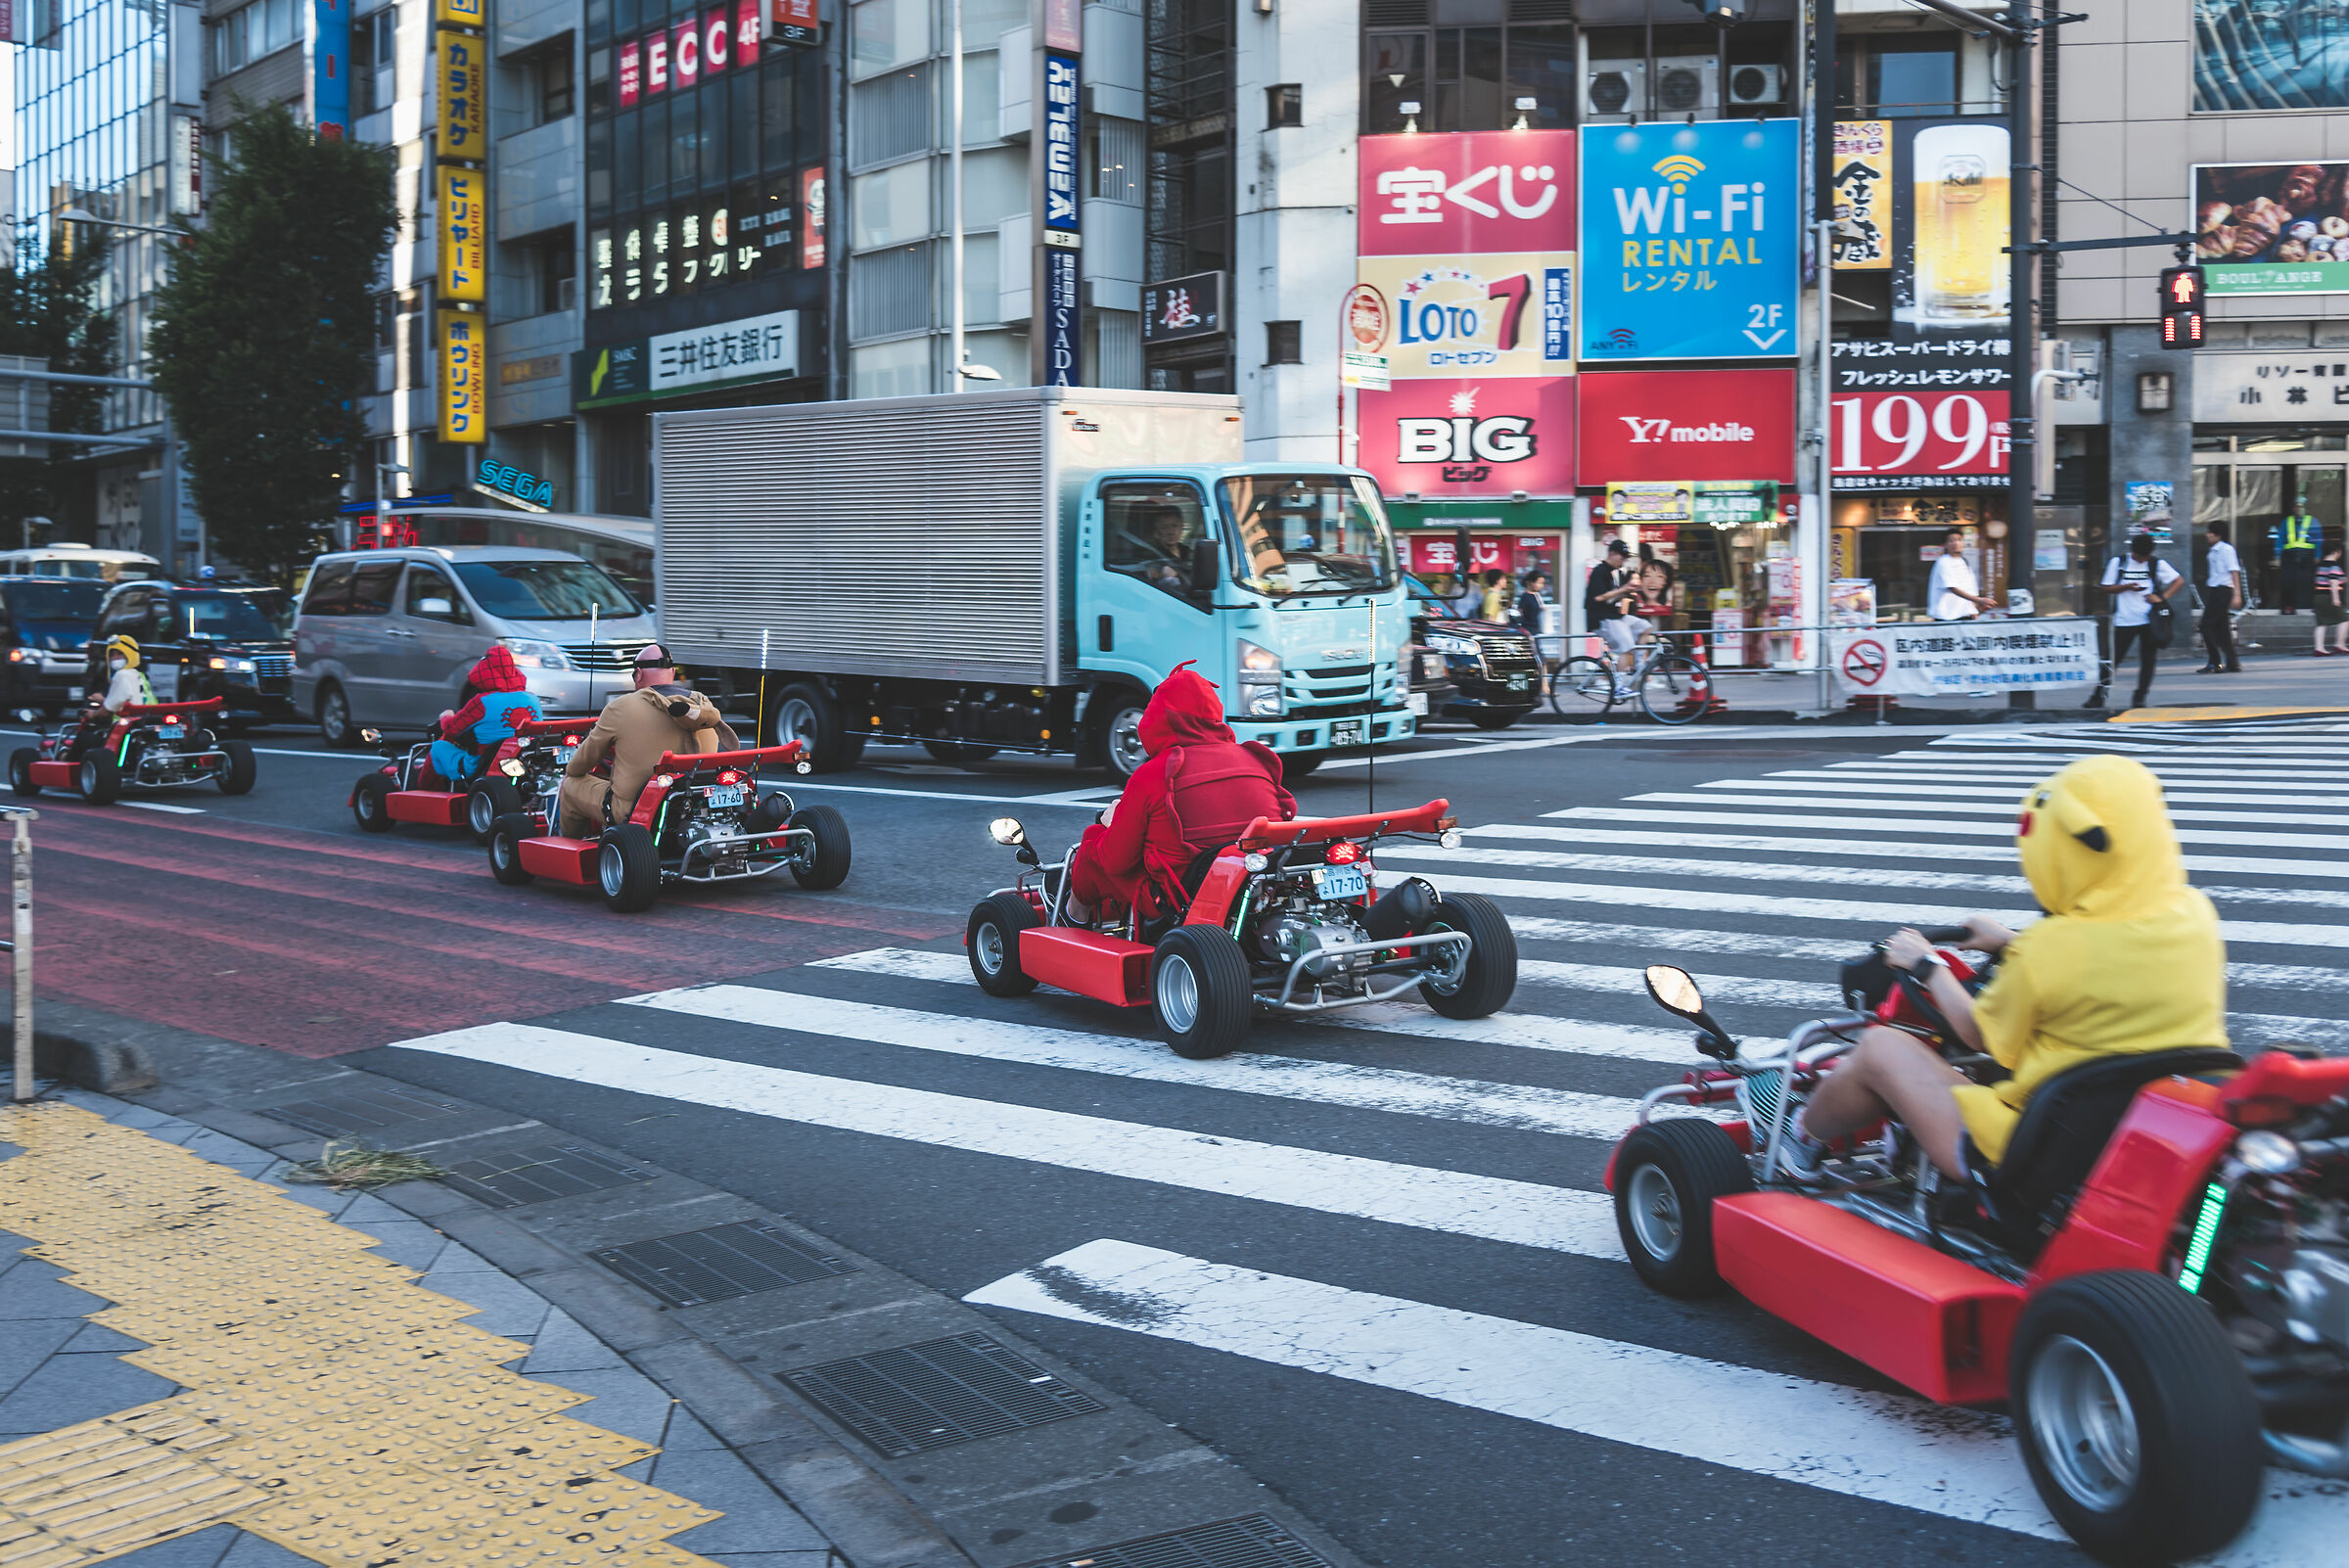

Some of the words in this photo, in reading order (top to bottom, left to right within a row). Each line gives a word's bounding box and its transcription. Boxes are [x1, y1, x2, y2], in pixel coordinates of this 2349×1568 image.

[650, 21, 727, 85] ECC
[783, 25, 806, 38] 3F
[449, 43, 468, 146] カラオケ
[1048, 61, 1071, 220] WEMBLEY
[1377, 164, 1558, 224] 宝くじ
[1613, 182, 1766, 234] Wi-Fi
[450, 177, 470, 289] ビリヤード
[1623, 238, 1763, 267] RENTAL
[1623, 270, 1718, 292] レンタル
[1400, 299, 1477, 345] LOTO
[1489, 274, 1532, 350] 7
[1747, 304, 1783, 328] 2F
[660, 324, 783, 378] 三井住友銀行
[1430, 351, 1497, 366] ロトセブン
[1398, 416, 1538, 463] BIG
[478, 459, 553, 507] SEGA
[1443, 467, 1492, 483] ビッグ
[1426, 542, 1498, 564] 宝じ
[1330, 876, 1363, 895] 17-70
